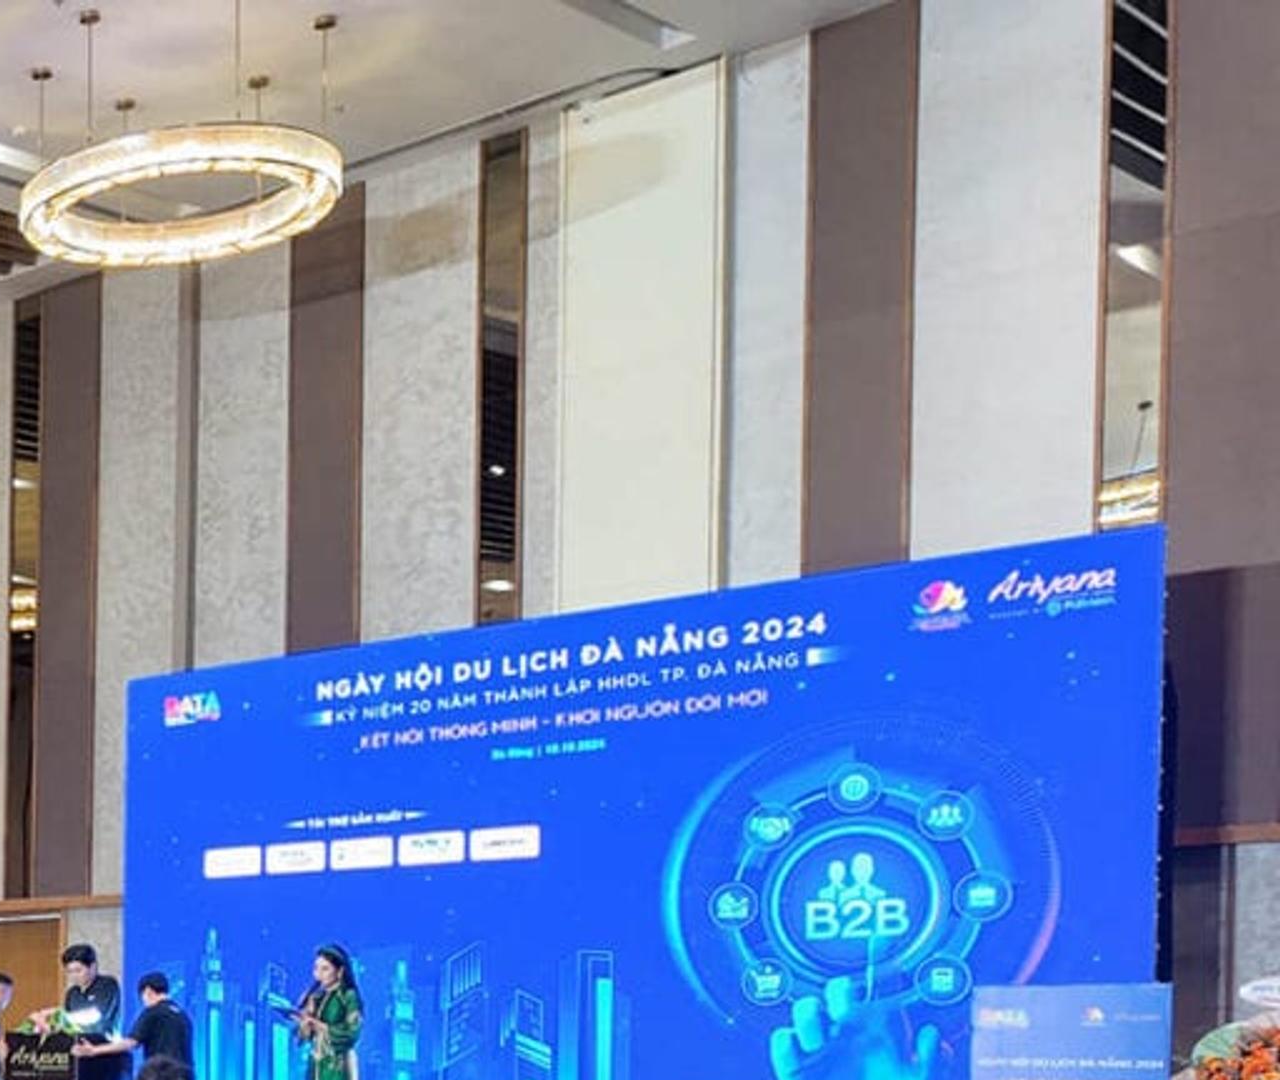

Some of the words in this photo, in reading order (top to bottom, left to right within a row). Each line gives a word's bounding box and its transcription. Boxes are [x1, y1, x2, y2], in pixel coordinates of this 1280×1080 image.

[316, 670, 386, 702] NGÀY
[394, 661, 443, 692] HỘI
[453, 658, 491, 683] DU
[501, 648, 569, 680] LỊCH
[579, 636, 624, 667] ĐÀ
[741, 611, 827, 645] 2024
[409, 698, 432, 715] 20
[597, 672, 652, 692] HHDL
[696, 658, 728, 680] ĐÀ
[805, 898, 910, 940] B2B
